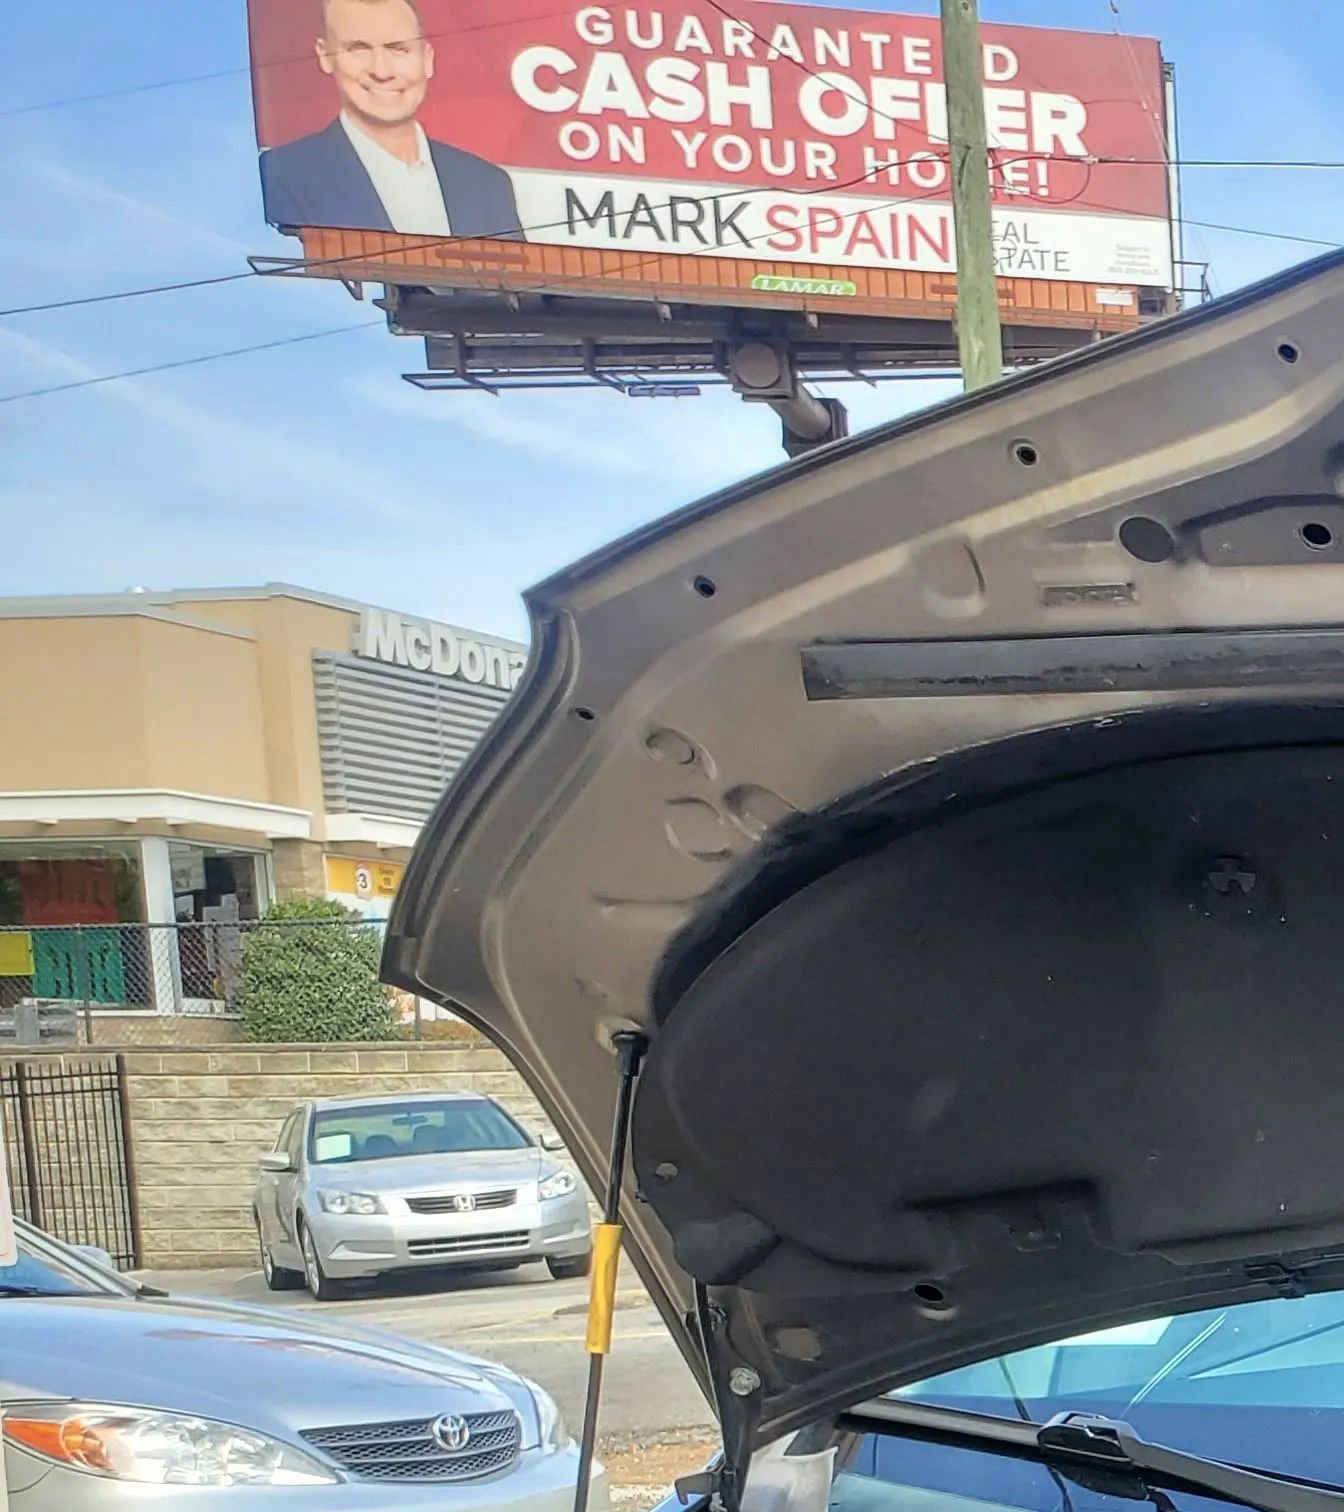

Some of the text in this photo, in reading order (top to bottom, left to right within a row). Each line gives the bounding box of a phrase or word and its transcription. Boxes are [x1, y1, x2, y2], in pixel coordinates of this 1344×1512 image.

[574, 6, 1019, 82] GUARANTED
[510, 45, 773, 130] CASH
[557, 120, 1050, 197] ON YOUR HOE!
[564, 187, 950, 265] MARK SPAIN
[762, 279, 844, 296] LAMAR
